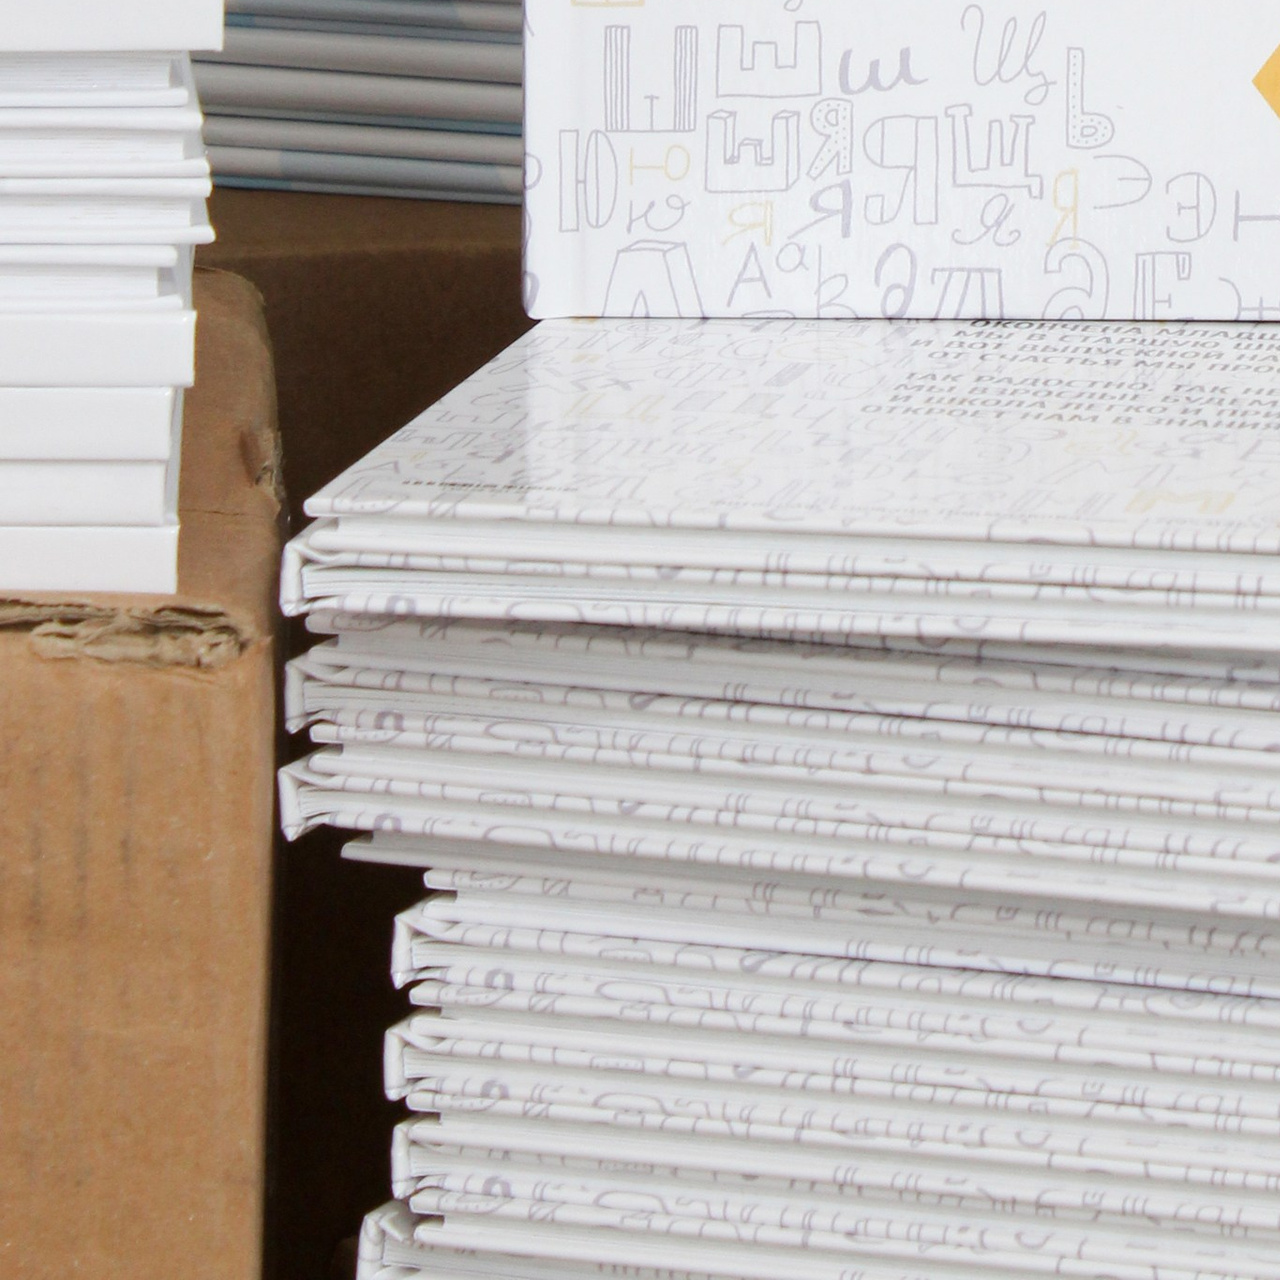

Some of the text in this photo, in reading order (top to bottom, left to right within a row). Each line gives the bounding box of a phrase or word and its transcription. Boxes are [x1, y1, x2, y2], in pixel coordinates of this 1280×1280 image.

[909, 339, 934, 348] И
[943, 341, 1004, 351] ВОТ
[1016, 343, 1217, 361] ВЫПУСКНОЙ
[953, 330, 1015, 341] МЫ
[1026, 333, 1046, 342] В
[1060, 334, 1221, 350] СТАРШУЮ
[927, 351, 971, 361] ОТ
[978, 353, 1122, 367] СЧАСТЬЯ
[1133, 359, 1195, 371] МЫ
[905, 372, 964, 383] ТАК
[1171, 383, 1231, 395] ТАК
[892, 383, 960, 394] МЫ
[967, 387, 1150, 403] ВЗРОСЛЫЕ
[1160, 395, 1279, 409] БУДЕМ
[924, 396, 1048, 410] ШКОЛА
[1059, 402, 1169, 416] ЛЕГКО
[859, 404, 1008, 421] ОТКРОЕТ
[1020, 410, 1100, 424] НАМ
